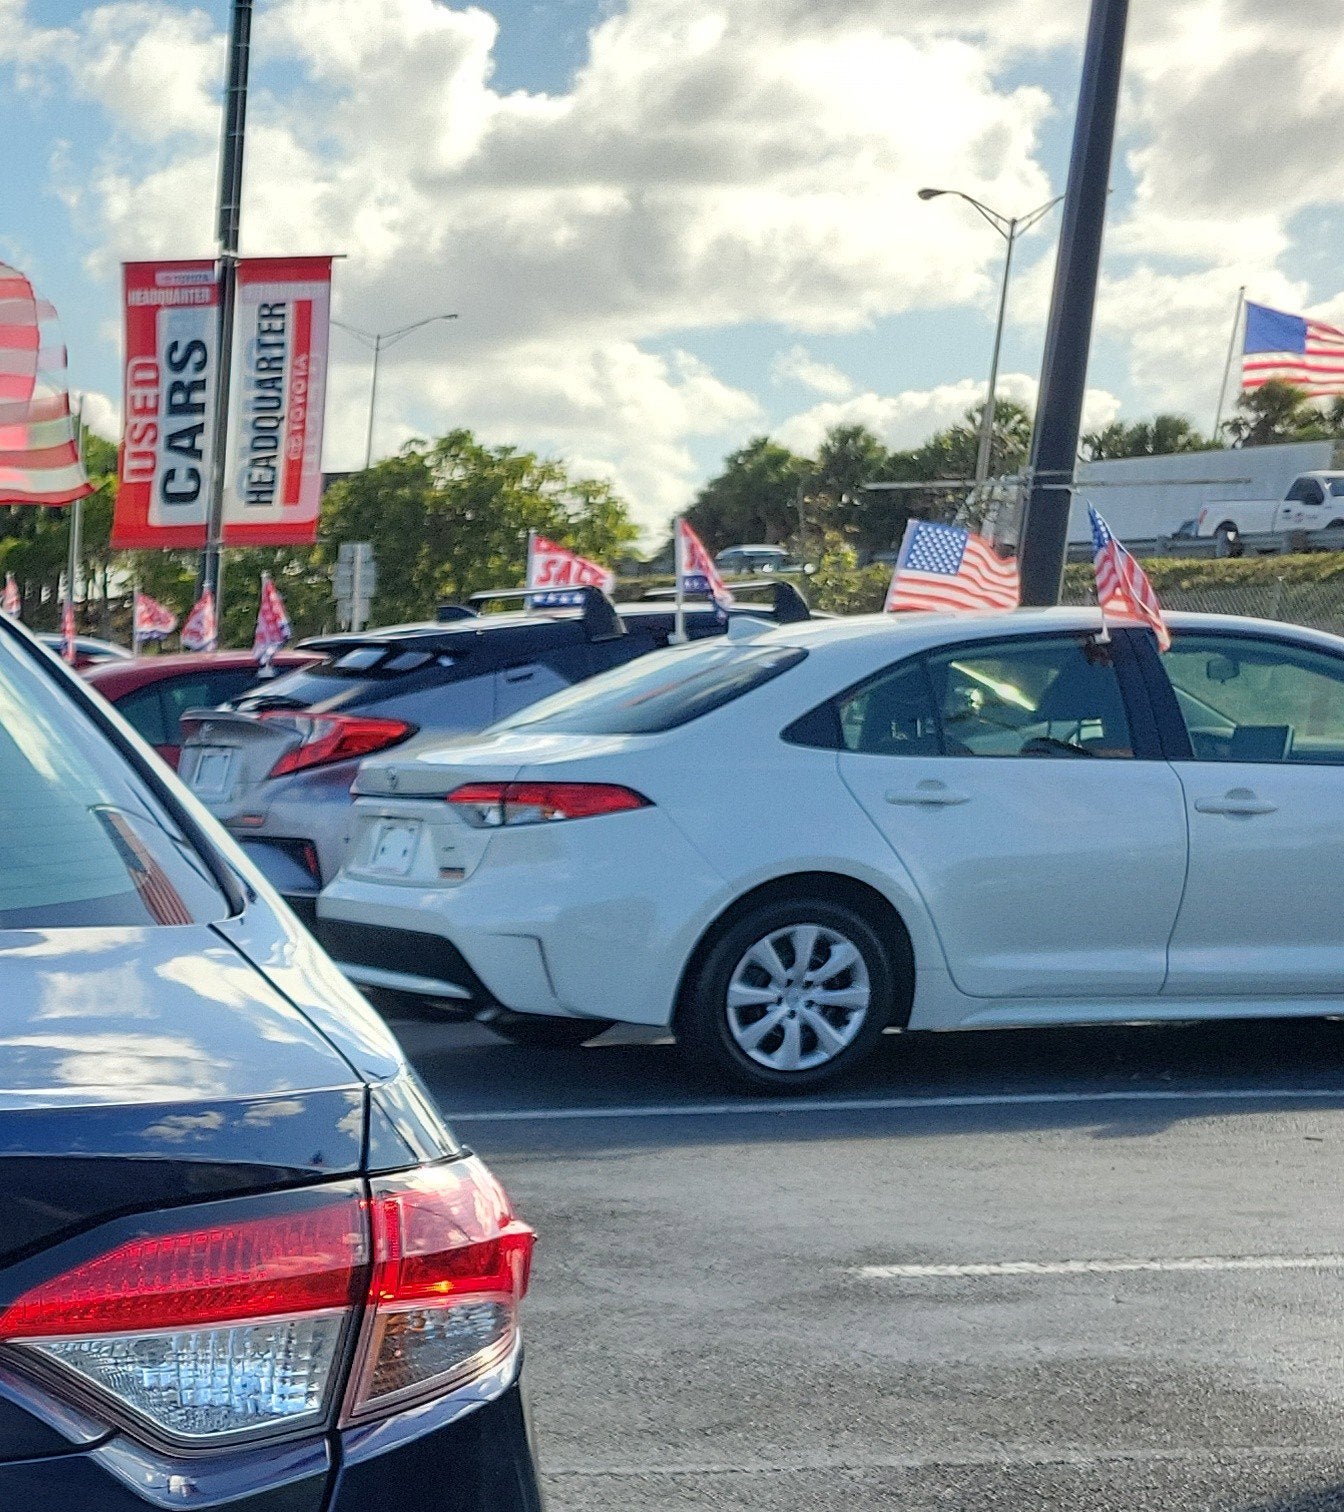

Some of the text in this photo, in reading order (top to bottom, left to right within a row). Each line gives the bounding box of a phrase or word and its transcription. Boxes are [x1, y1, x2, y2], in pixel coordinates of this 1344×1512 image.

[127, 360, 160, 478] USED
[162, 339, 208, 505] CARS
[246, 301, 287, 506] HEADQUARTER
